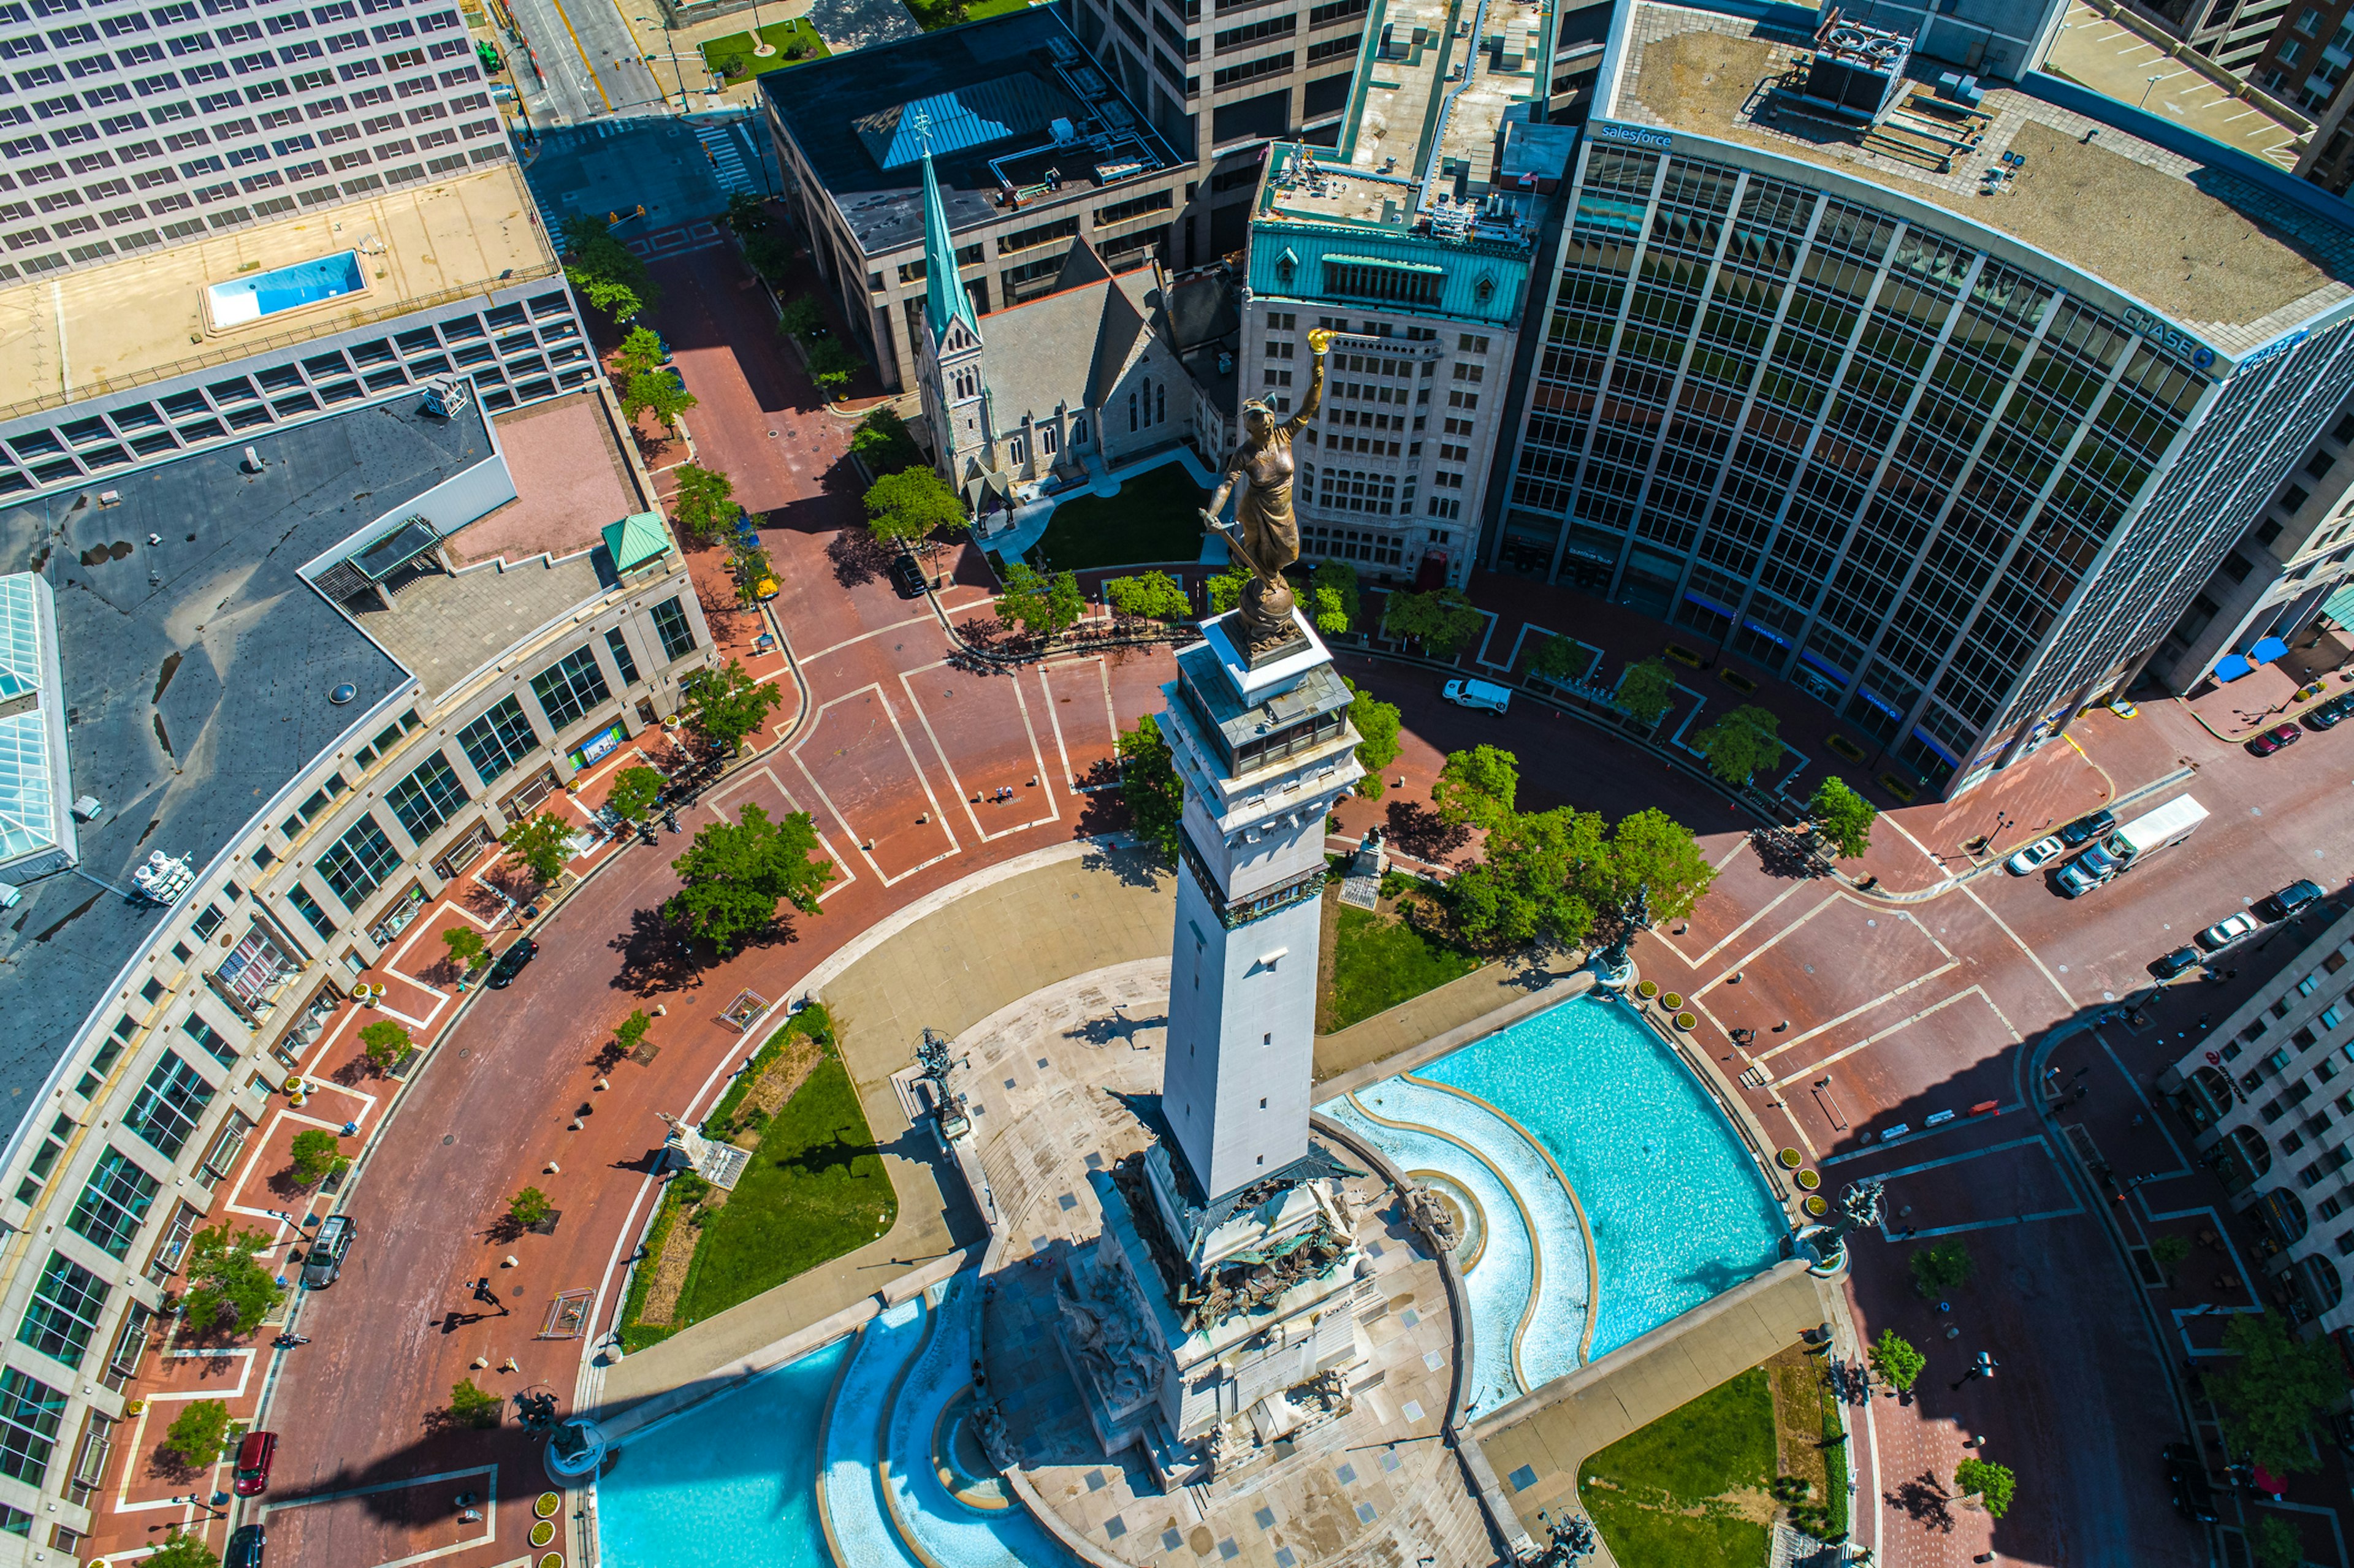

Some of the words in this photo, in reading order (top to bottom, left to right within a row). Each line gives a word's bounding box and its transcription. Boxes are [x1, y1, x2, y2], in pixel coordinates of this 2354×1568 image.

[1602, 126, 1671, 147] salesforce
[2123, 308, 2194, 356] CHASE
[1753, 625, 1776, 640] CHASE
[1867, 695, 1889, 712] CHASE
[2219, 1065, 2247, 1104] ambrose
